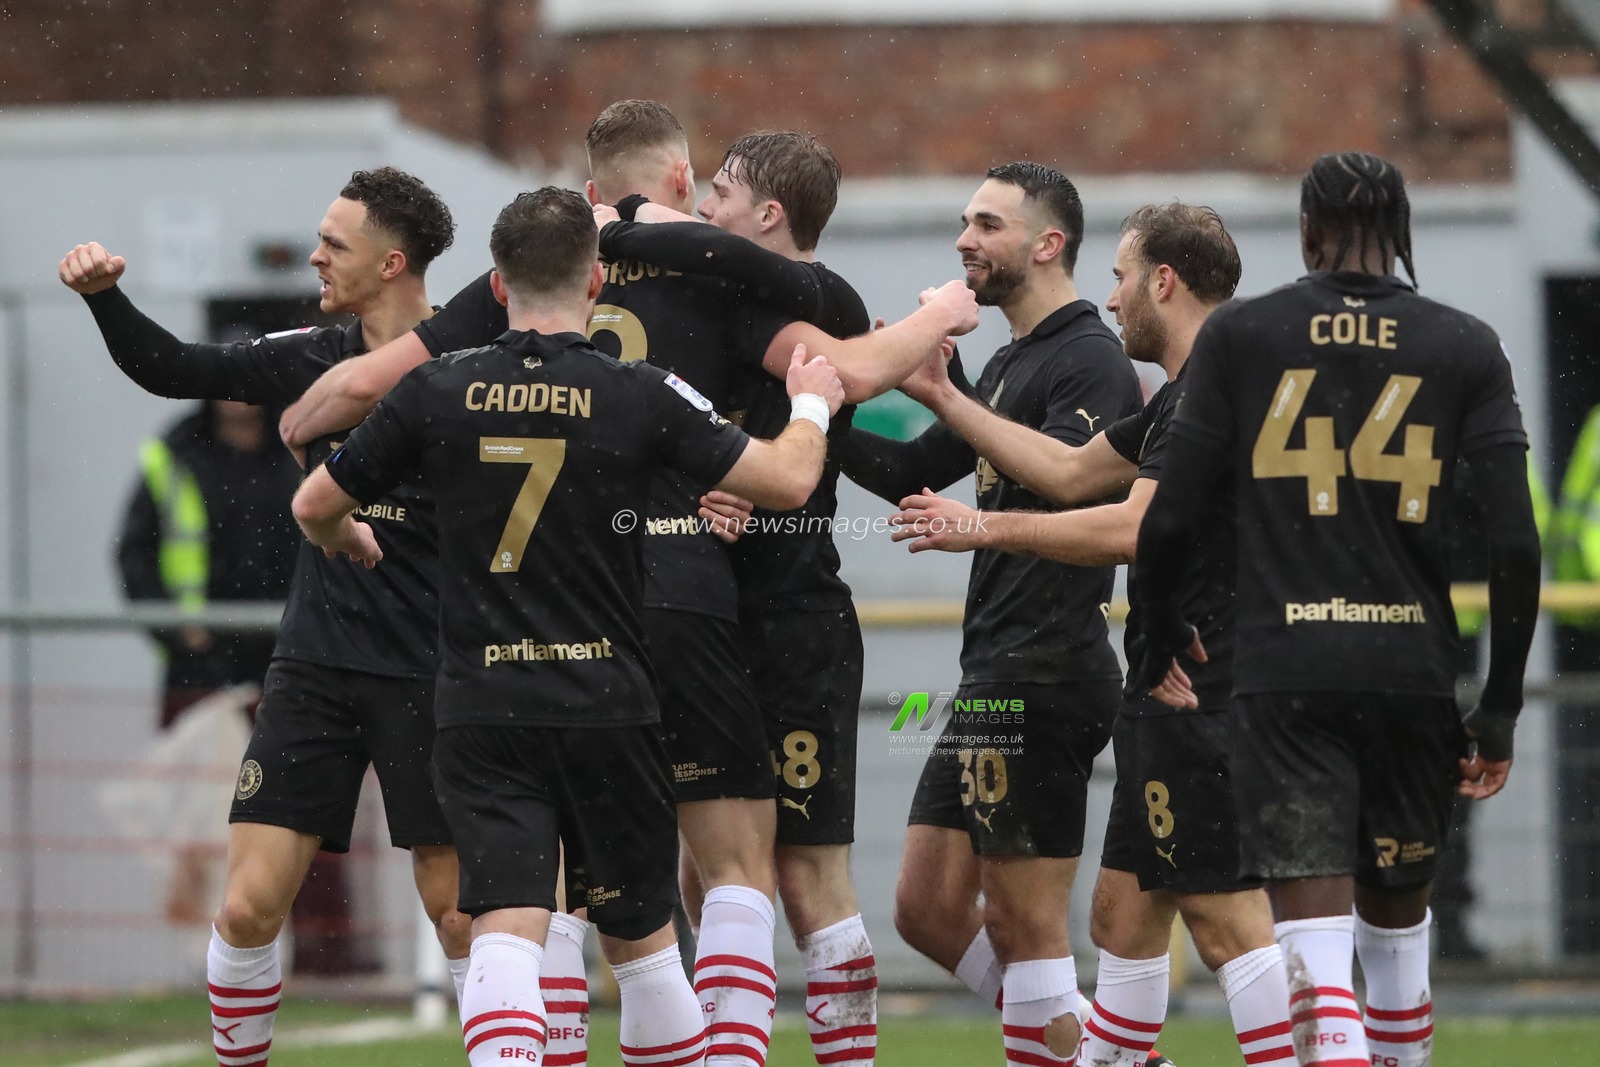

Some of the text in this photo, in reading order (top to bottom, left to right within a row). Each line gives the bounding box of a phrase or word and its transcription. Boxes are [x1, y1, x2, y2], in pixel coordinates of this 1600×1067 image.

[1310, 312, 1398, 350] COLE
[465, 381, 592, 418] CADDEN
[1252, 368, 1443, 524] 44
[479, 436, 567, 573] 7
[1285, 597, 1426, 625] parliament
[485, 637, 612, 667] parliament
[1145, 780, 1175, 839] 8
[549, 1027, 585, 1040] BFC
[1305, 1032, 1347, 1047] BFC
[500, 1047, 537, 1063] BFC
[1371, 1053, 1399, 1067] FC
